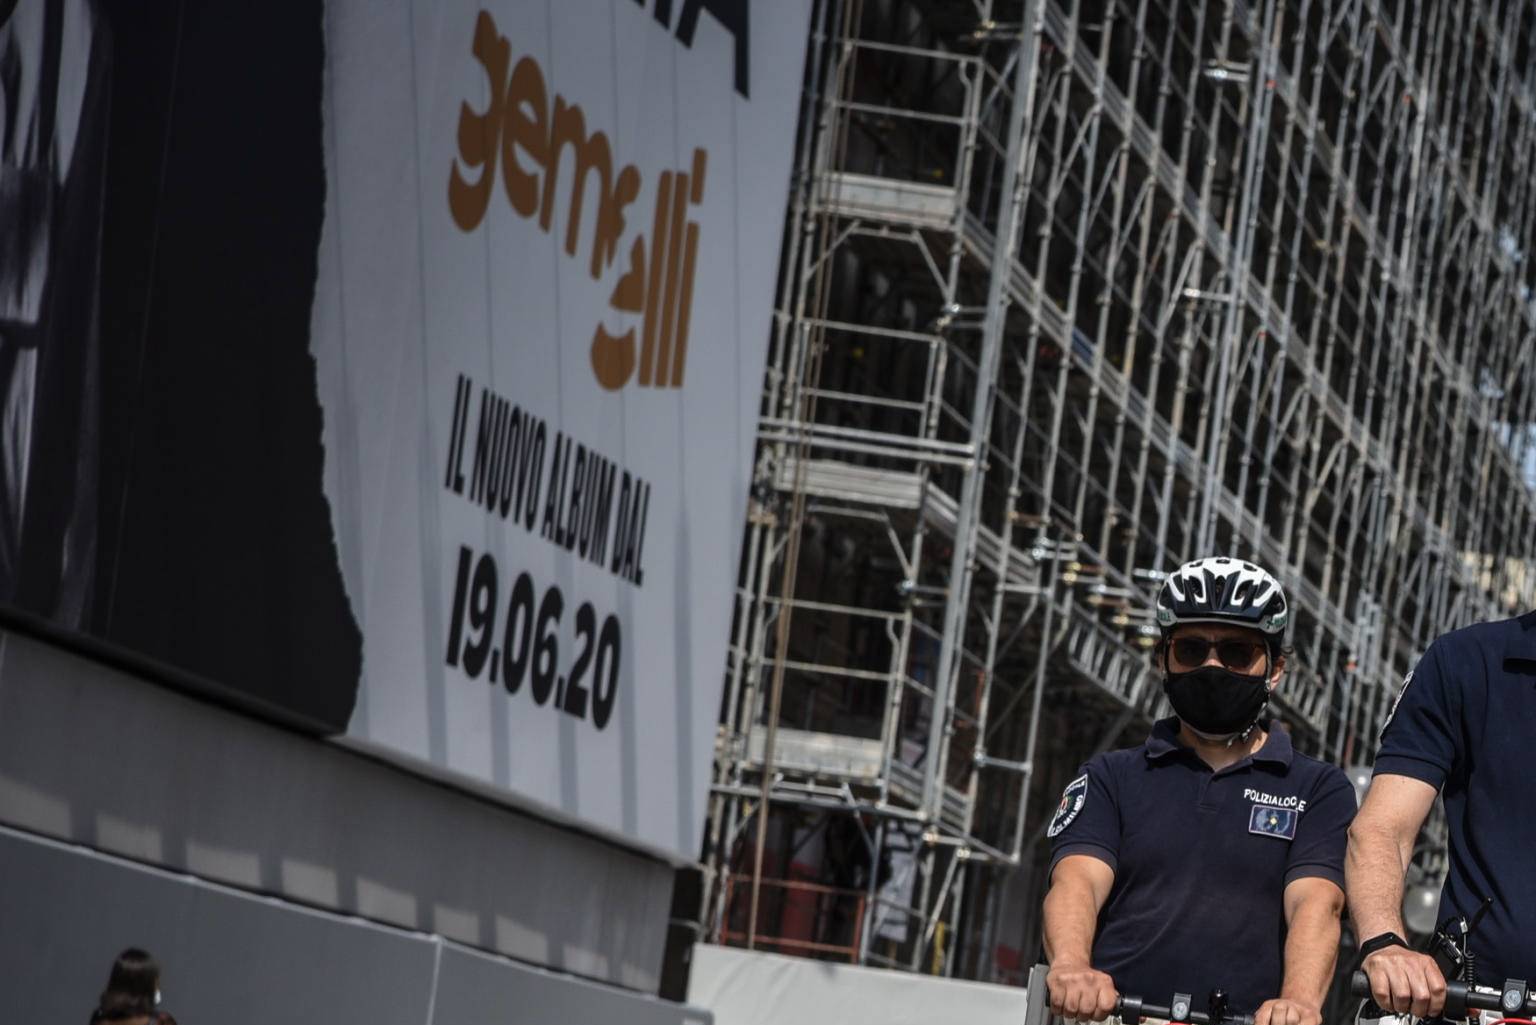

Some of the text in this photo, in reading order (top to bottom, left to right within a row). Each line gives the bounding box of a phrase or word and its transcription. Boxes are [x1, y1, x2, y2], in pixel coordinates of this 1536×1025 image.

[445, 373, 651, 587] IL NUOVO ALBUM DAL
[446, 544, 621, 731] 19.06.20
[1243, 788, 1278, 805] POLIZIA
